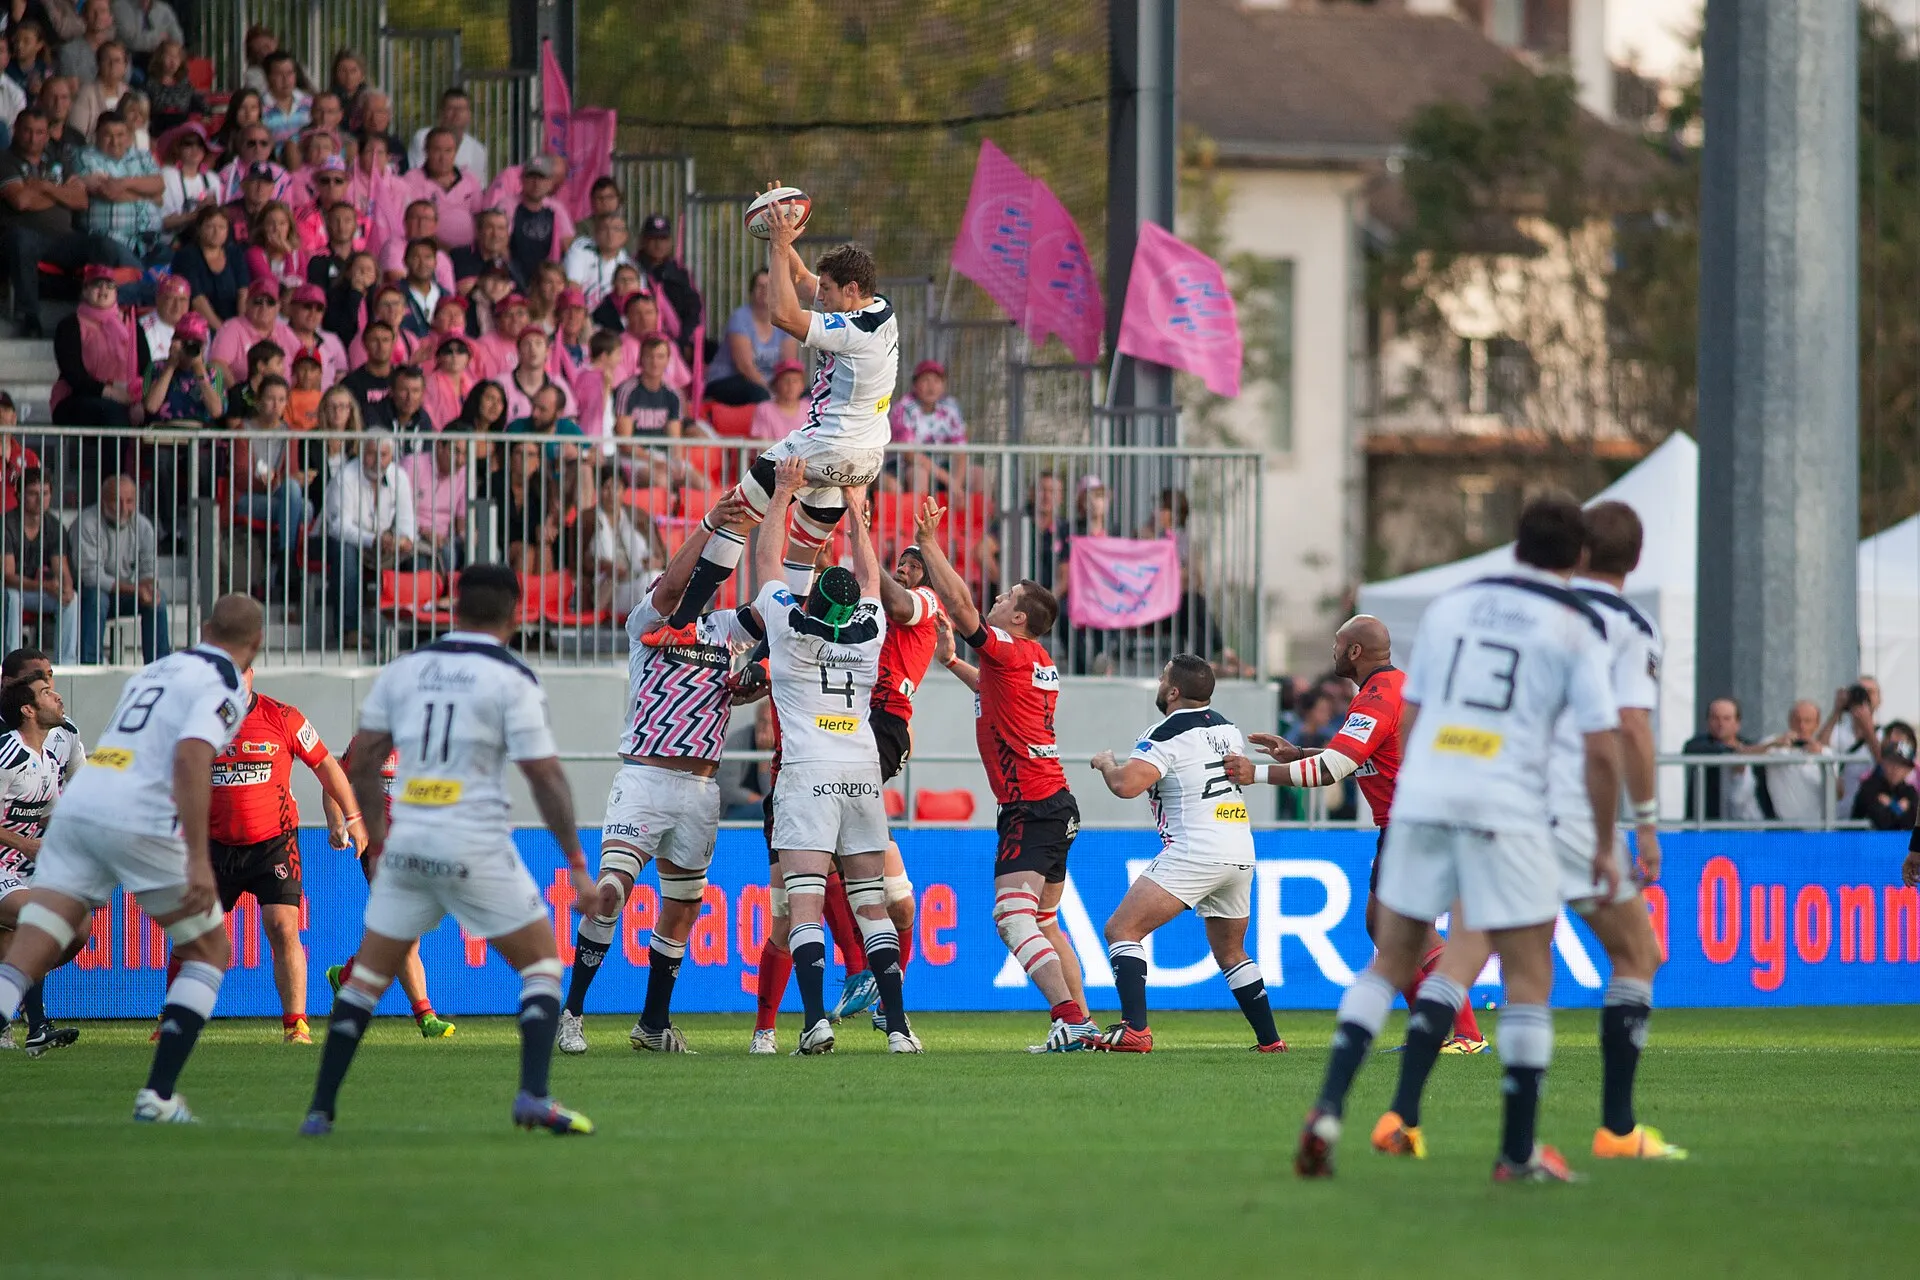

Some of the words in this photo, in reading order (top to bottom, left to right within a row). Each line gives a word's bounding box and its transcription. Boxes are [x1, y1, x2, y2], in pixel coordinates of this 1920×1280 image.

[822, 465, 875, 484] SCORPIO
[1444, 636, 1520, 712] 13
[820, 664, 855, 708] 4
[104, 687, 164, 733] 18
[422, 703, 454, 763] 11
[819, 719, 854, 731] Hertz
[243, 742, 278, 755] Smoby
[813, 783, 872, 797] SCORPIO
[1216, 807, 1247, 819] Hertz
[605, 823, 640, 837] antalis
[1698, 855, 1920, 992] Oyonn
